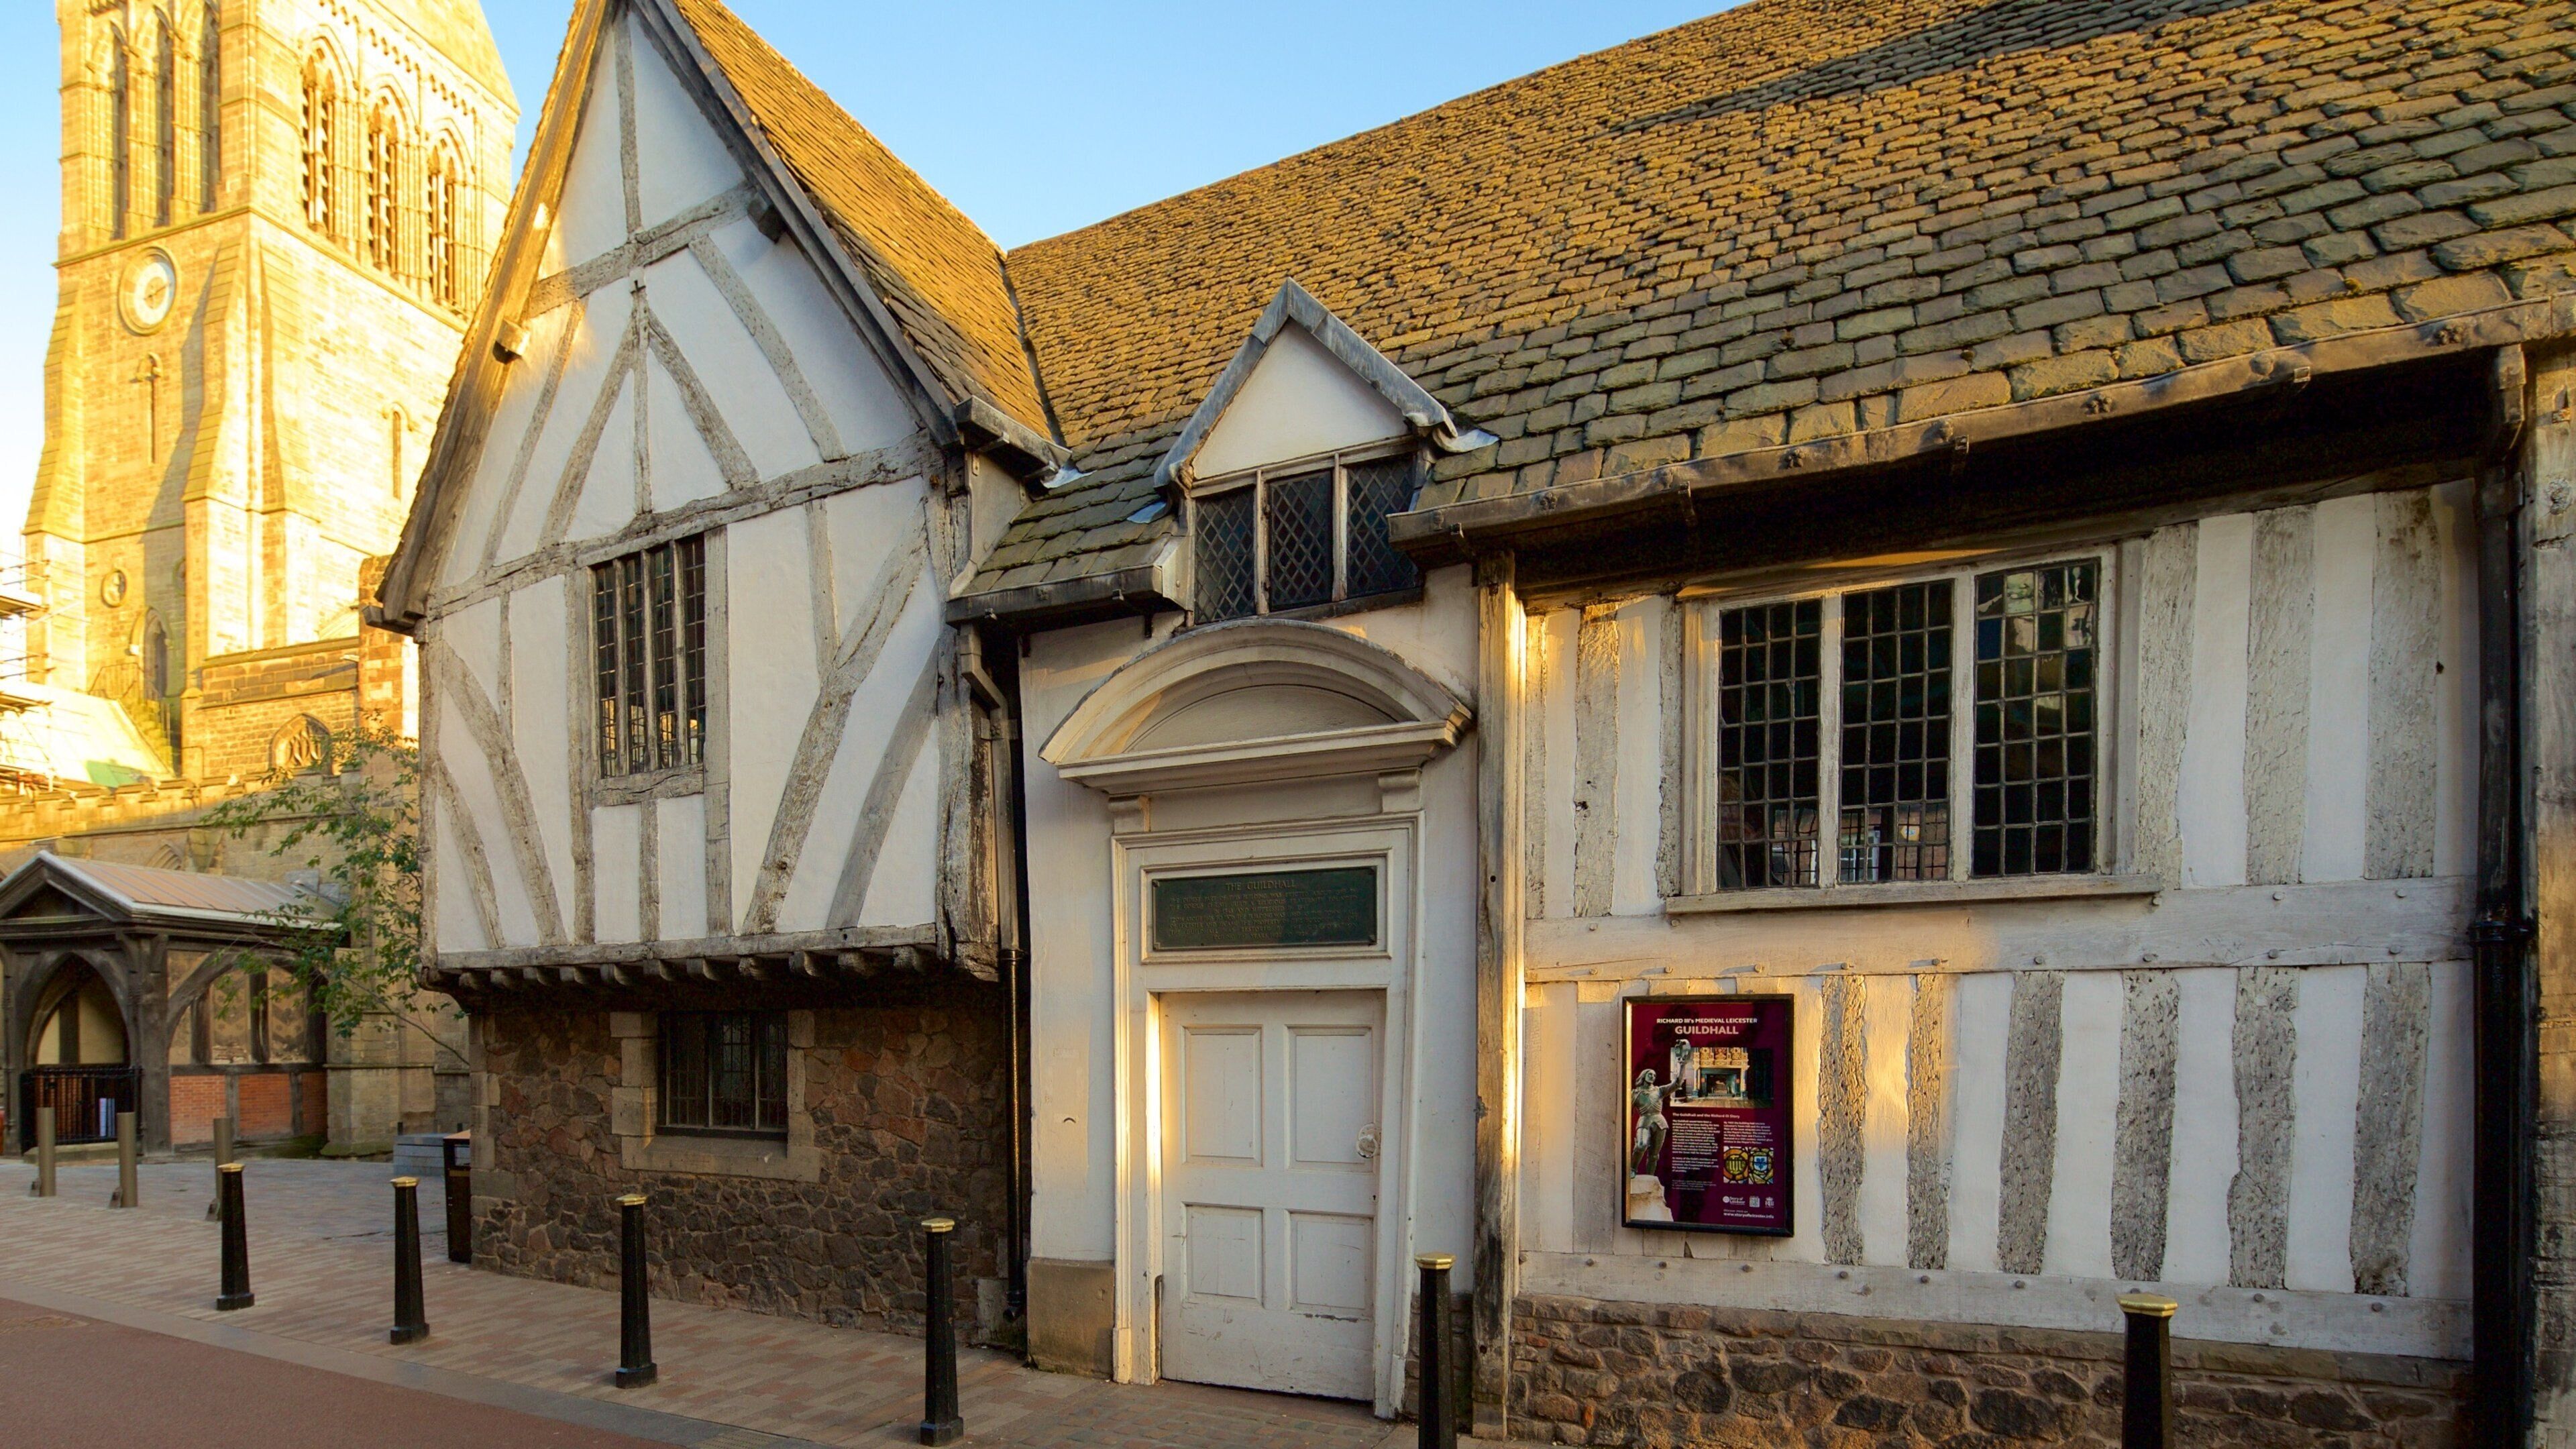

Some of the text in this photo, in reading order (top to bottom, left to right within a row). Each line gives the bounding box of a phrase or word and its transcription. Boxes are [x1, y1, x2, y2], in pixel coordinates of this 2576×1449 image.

[1226, 879, 1297, 891] THE GUILDHALL
[1674, 1026, 1739, 1034] GUILDHALL
